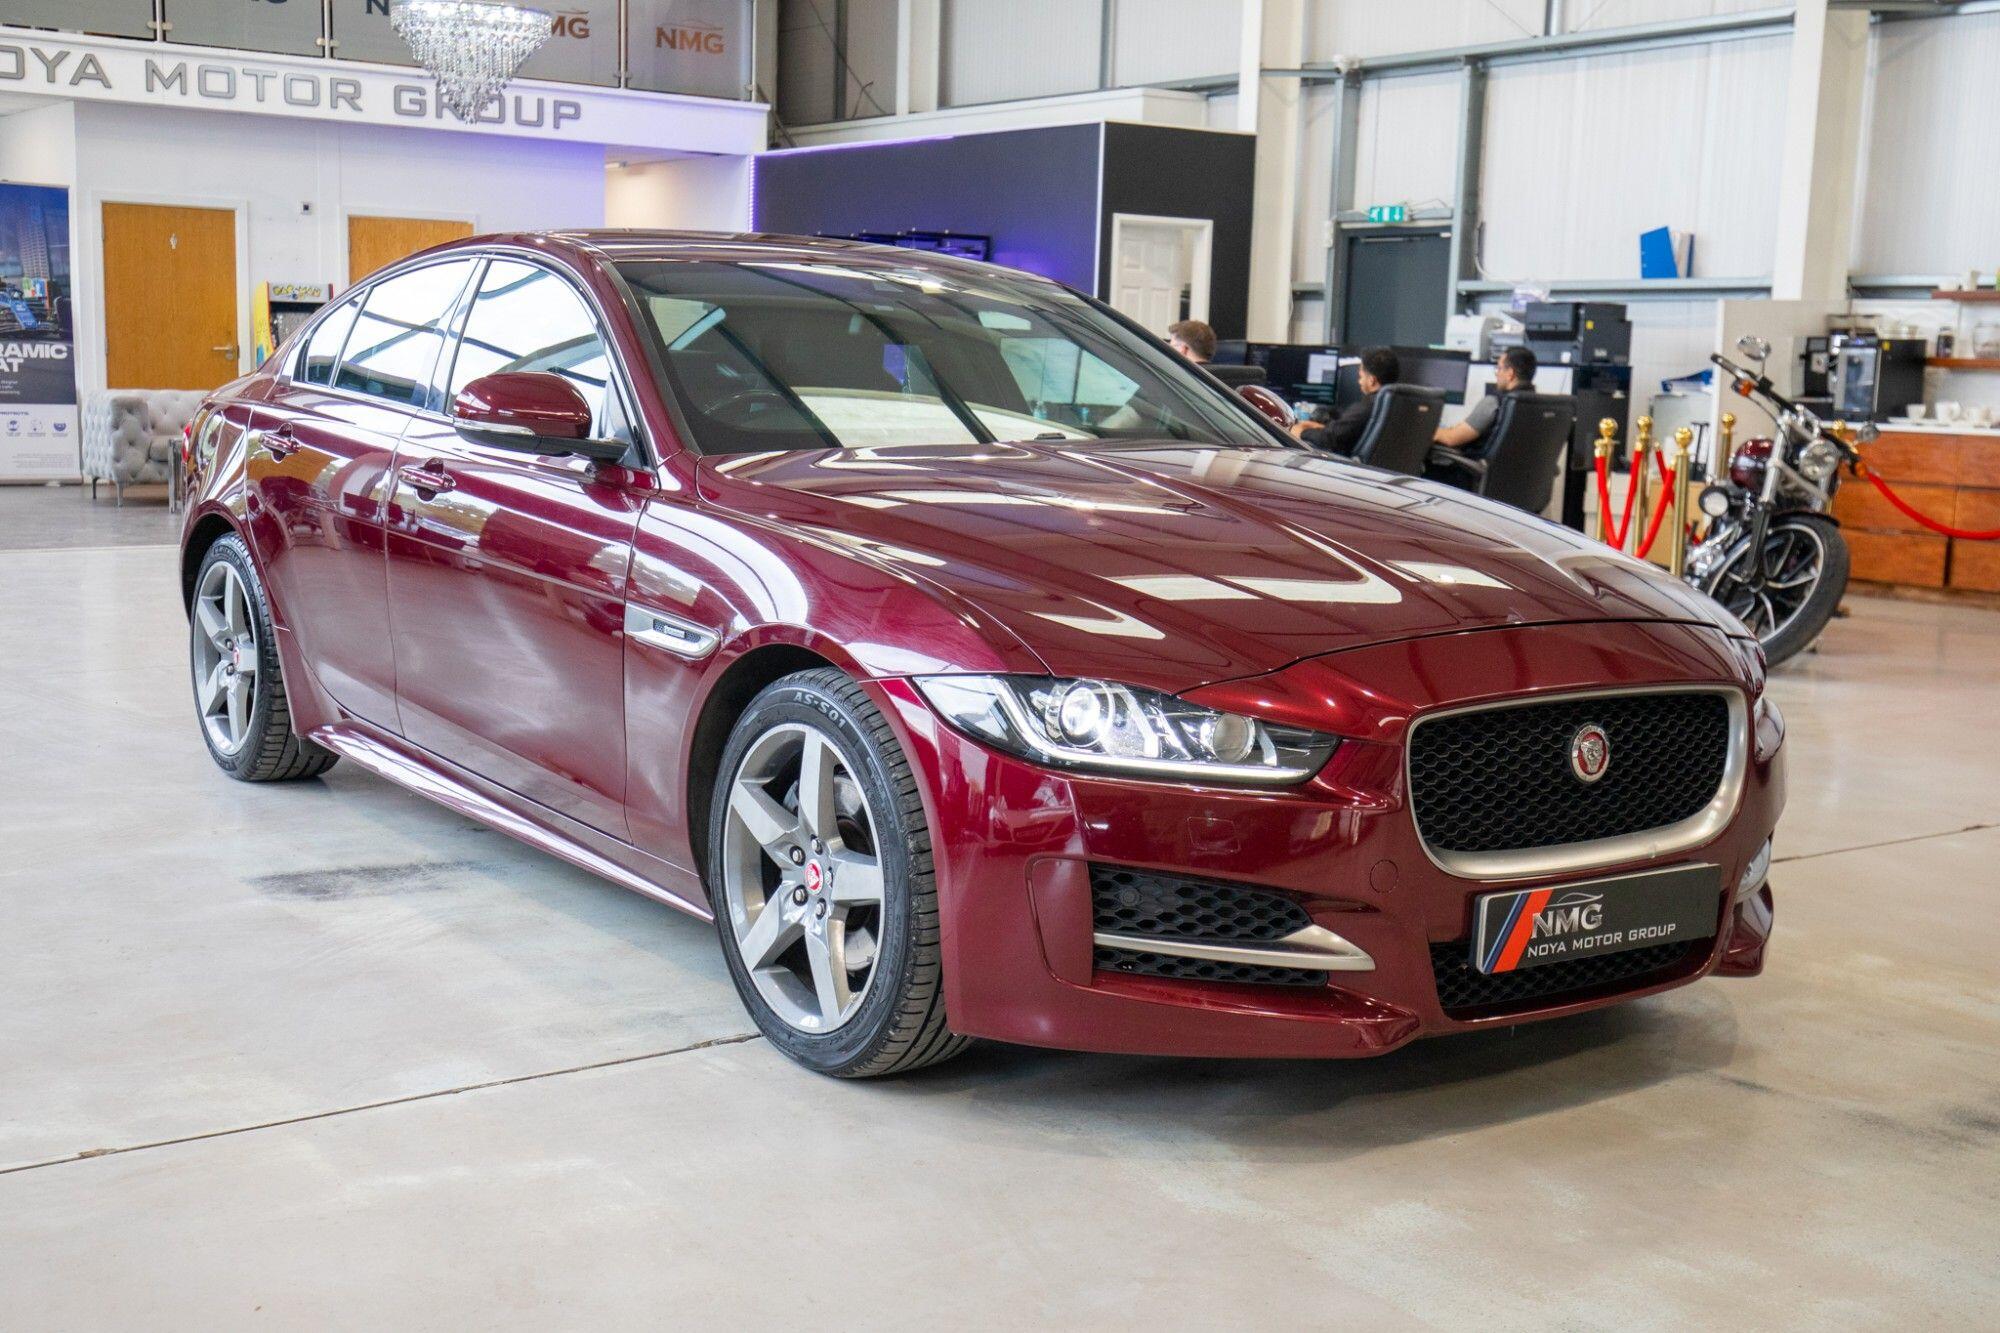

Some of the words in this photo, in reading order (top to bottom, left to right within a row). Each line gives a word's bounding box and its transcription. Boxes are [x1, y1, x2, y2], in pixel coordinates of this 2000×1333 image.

[551, 16, 590, 39] MG
[656, 26, 725, 54] NMG
[145, 59, 363, 112] MOTOR
[0, 343, 68, 359] AMIC
[1531, 903, 1603, 939] NMG
[1527, 941, 1566, 959] NOYA
[1572, 932, 1623, 951] MOTOR
[1628, 923, 1676, 942] GROUP
